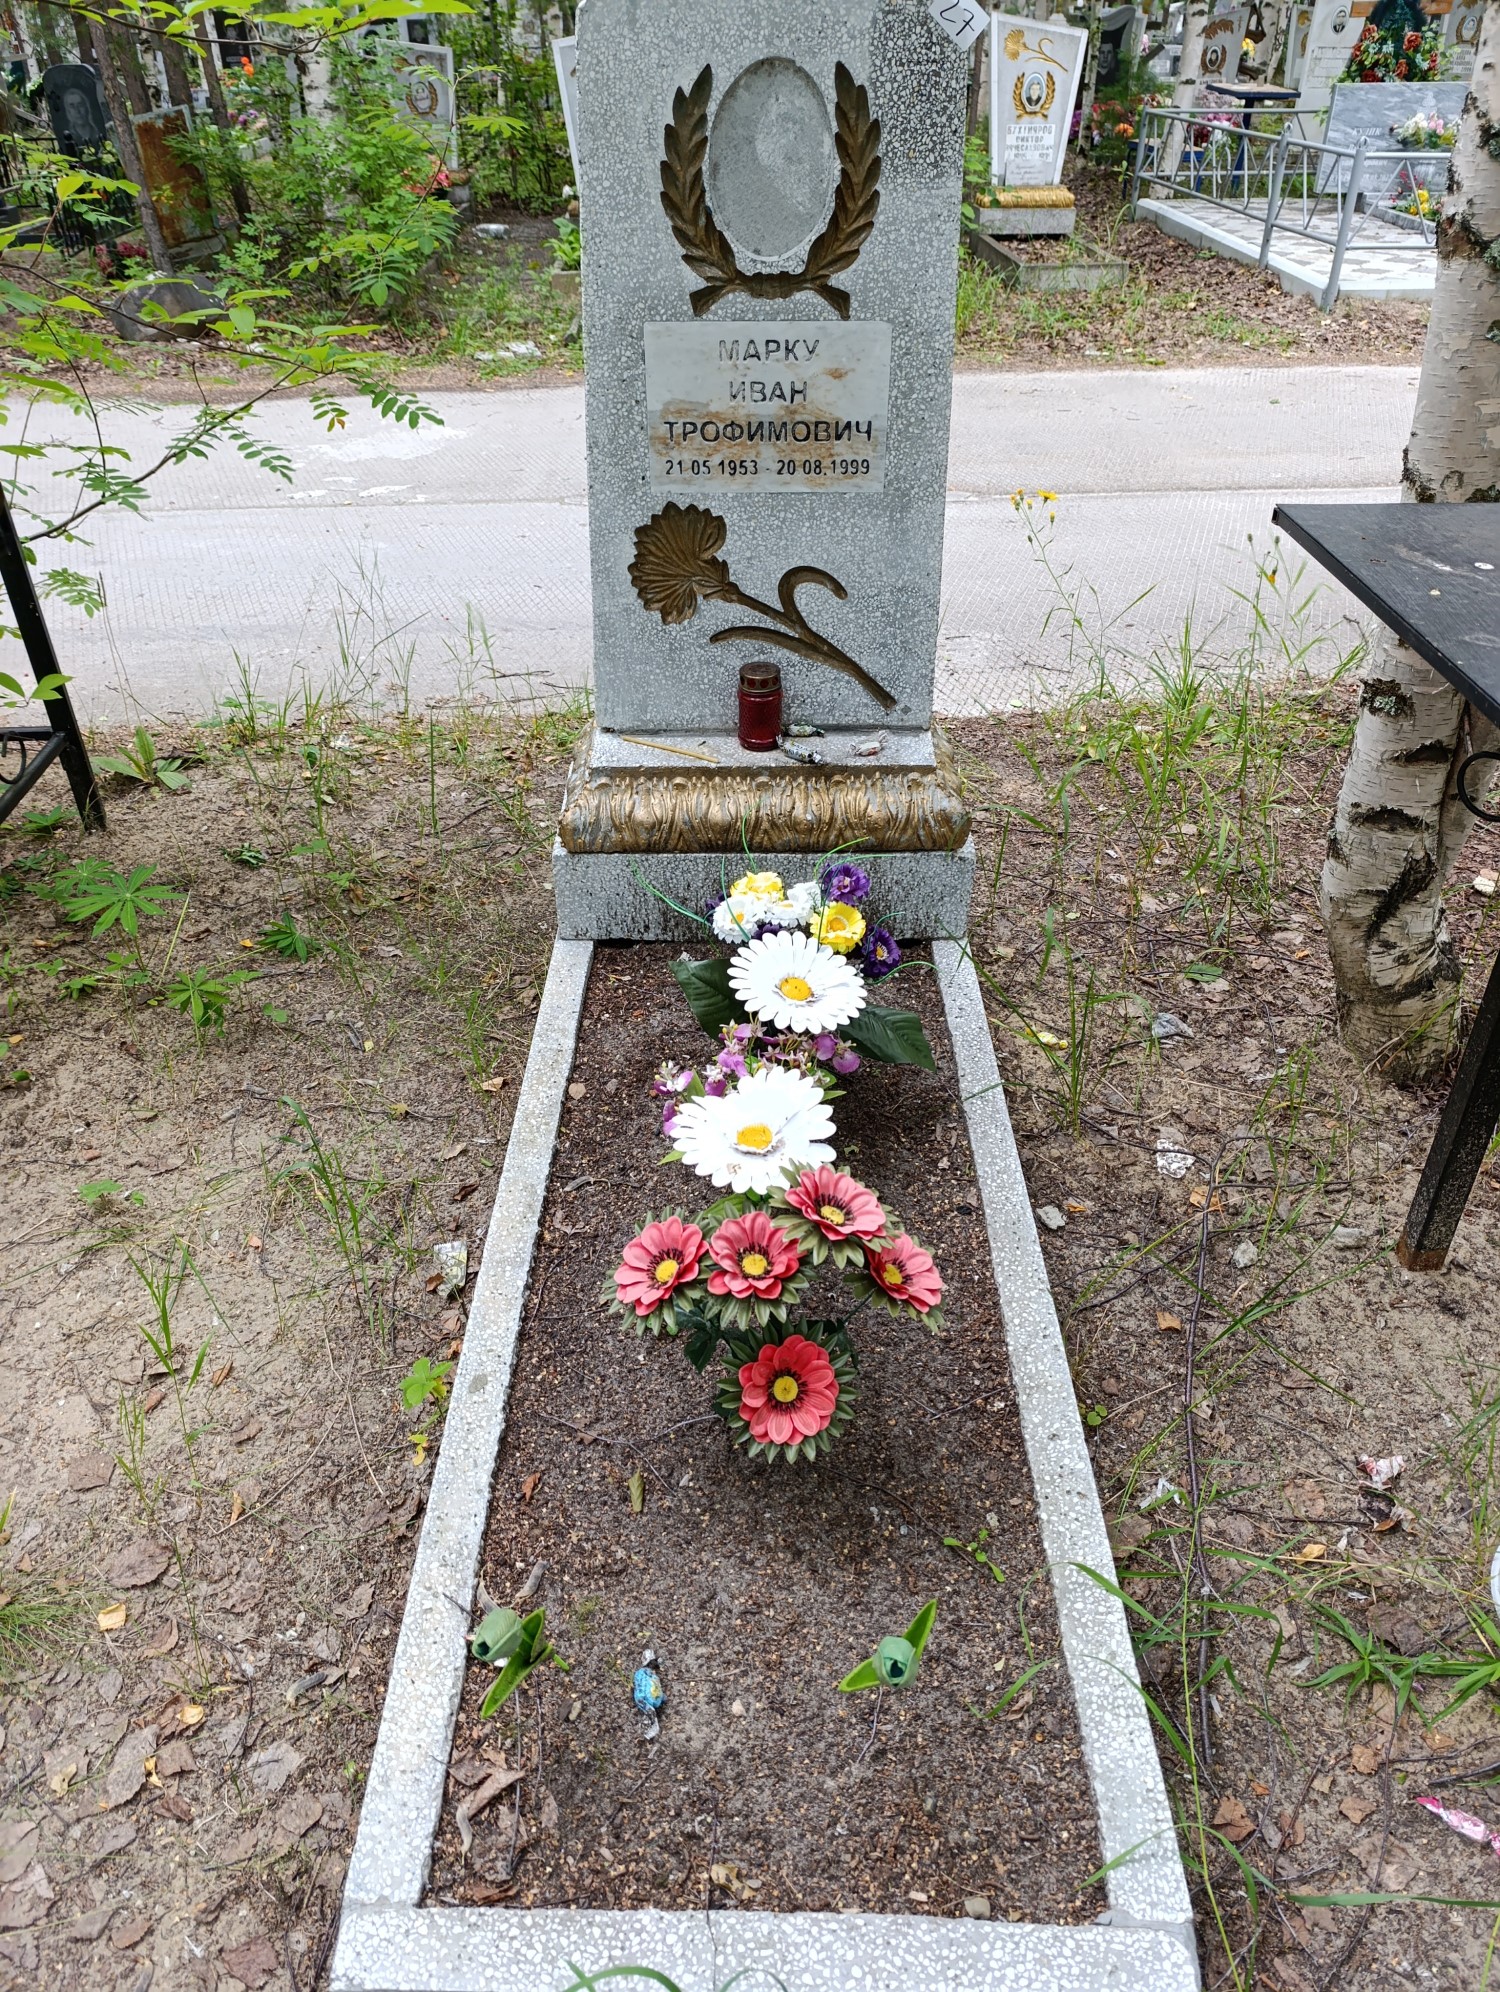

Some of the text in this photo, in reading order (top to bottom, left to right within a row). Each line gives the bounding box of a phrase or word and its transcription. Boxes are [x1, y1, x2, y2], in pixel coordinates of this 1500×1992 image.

[718, 339, 820, 362] МАРКУ
[729, 381, 808, 404] ИВАН
[664, 420, 873, 442] ТРОФИМОВИЧ
